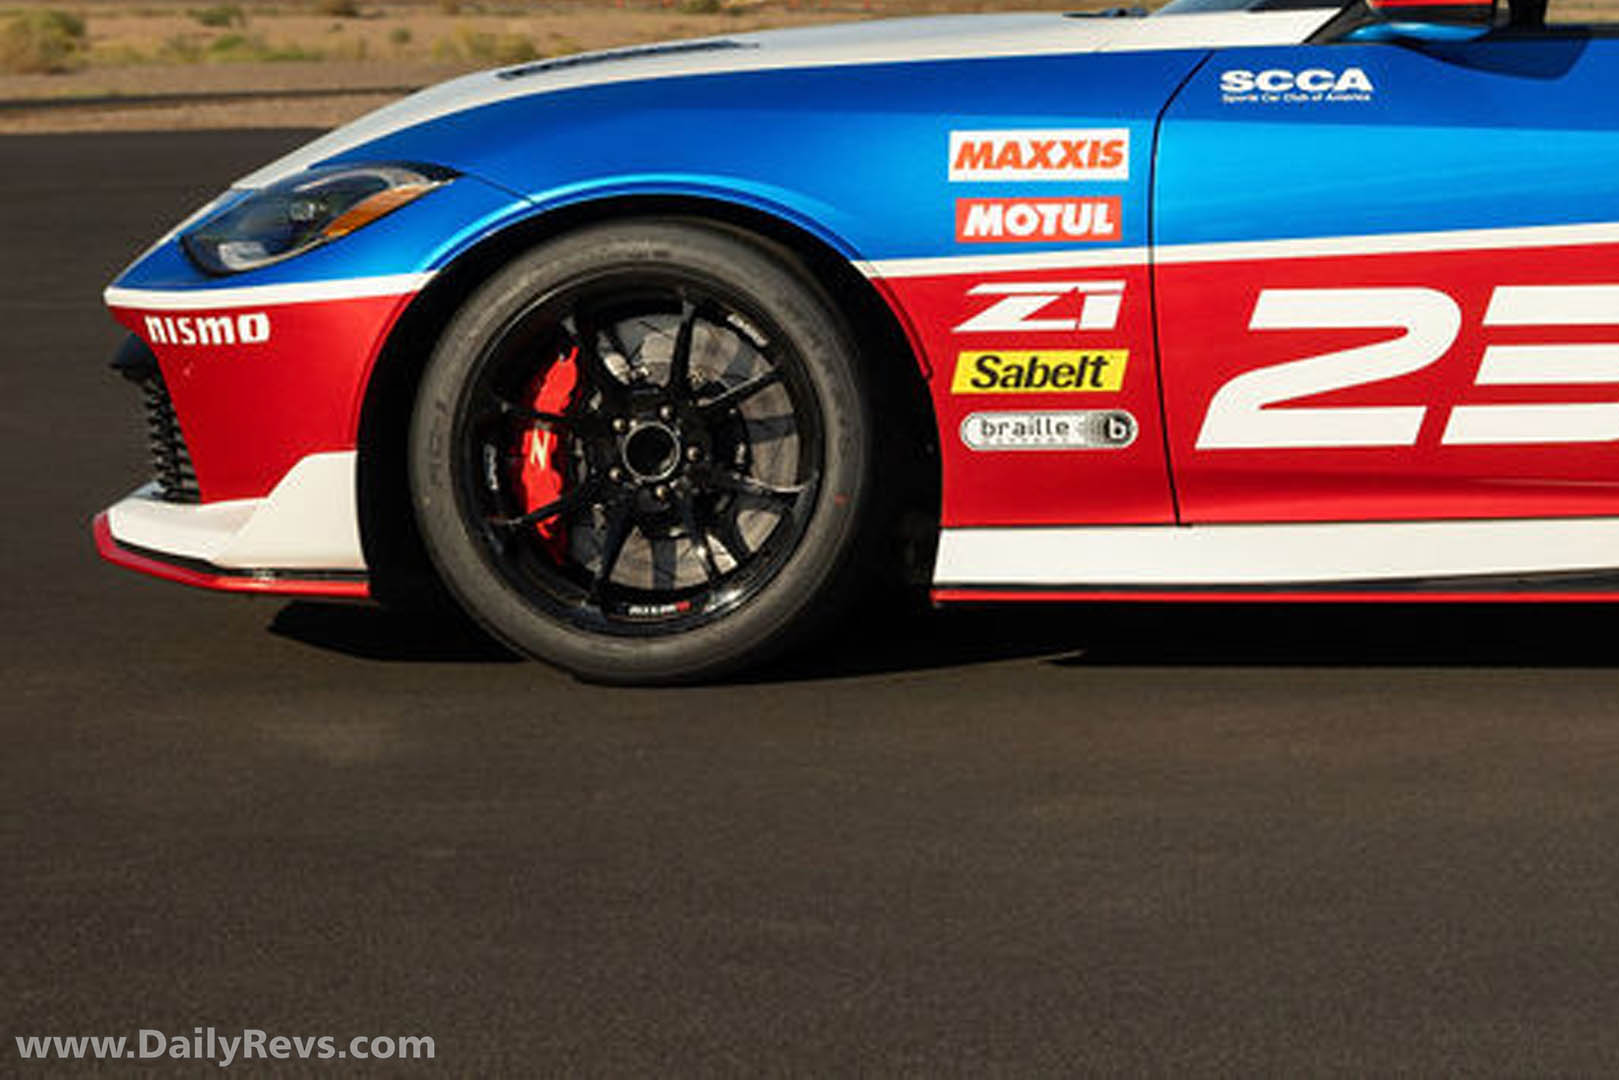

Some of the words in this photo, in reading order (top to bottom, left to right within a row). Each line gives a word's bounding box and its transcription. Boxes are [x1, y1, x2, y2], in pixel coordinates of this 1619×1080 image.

[1220, 68, 1374, 92] SCCA
[954, 139, 1125, 170] MAXXIS
[963, 202, 1114, 237] MOTUL
[952, 281, 1127, 333] Z1
[970, 355, 1109, 389] Sabelt
[980, 418, 1070, 437] braille
